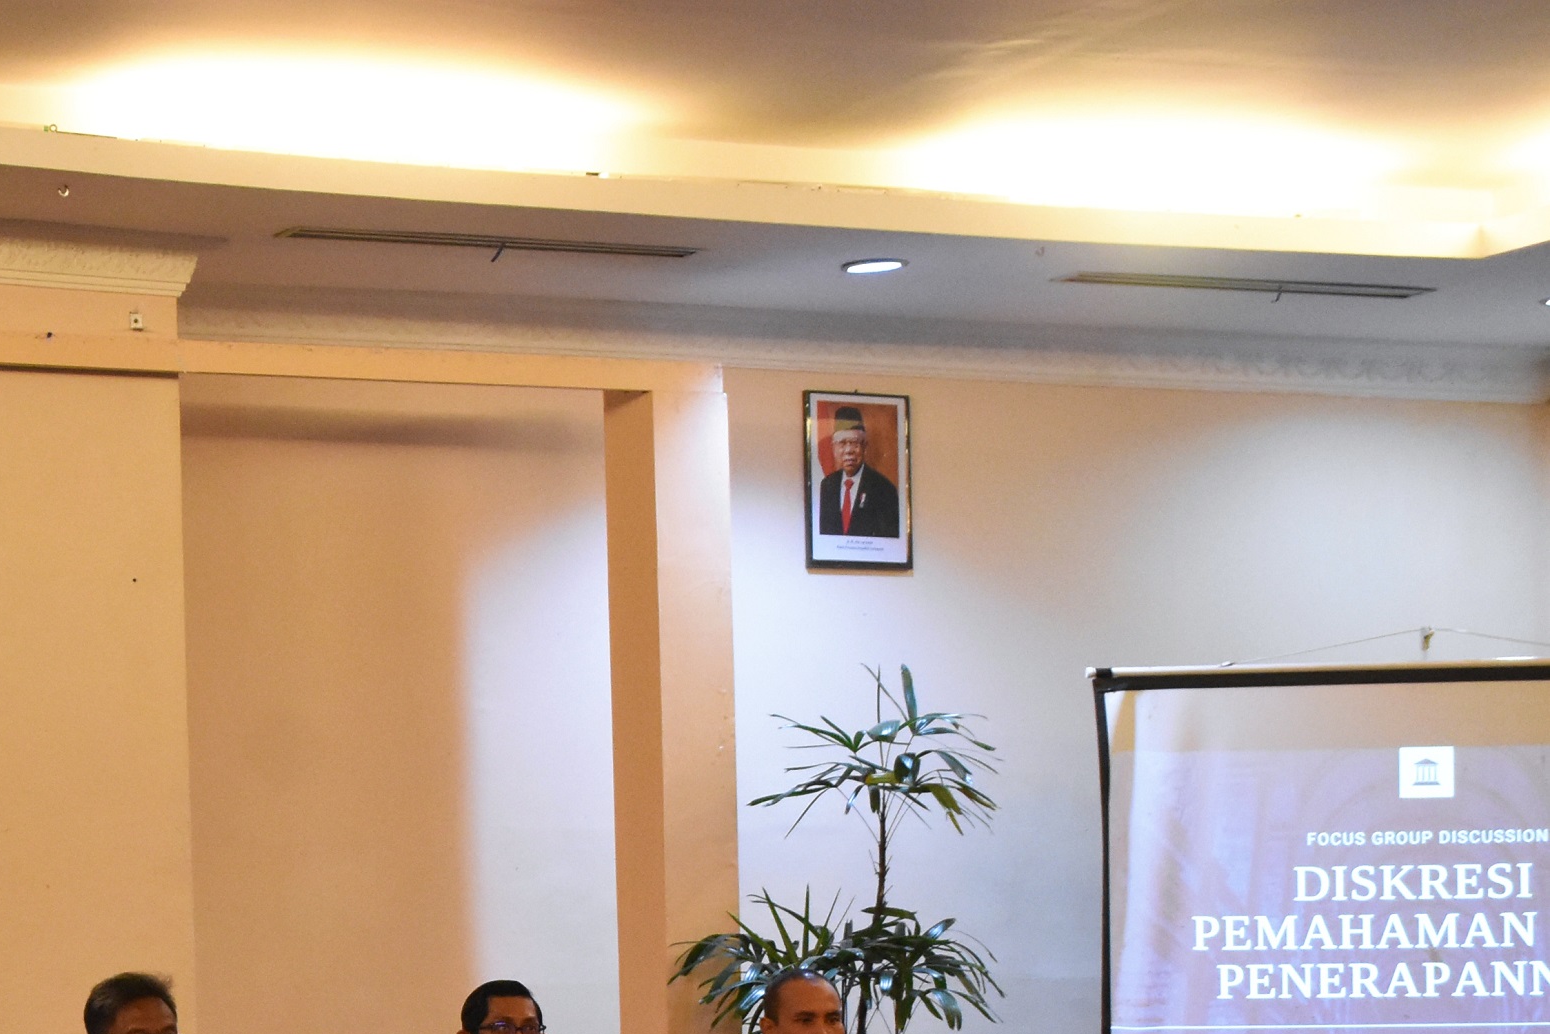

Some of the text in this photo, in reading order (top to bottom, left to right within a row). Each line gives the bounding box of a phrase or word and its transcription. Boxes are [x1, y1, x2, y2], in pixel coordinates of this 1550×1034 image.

[1306, 828, 1550, 847] FOCUS GROUP DISCUSSION
[1293, 863, 1533, 902] DISKRESI
[1191, 911, 1538, 951] PEMAHAMAN
